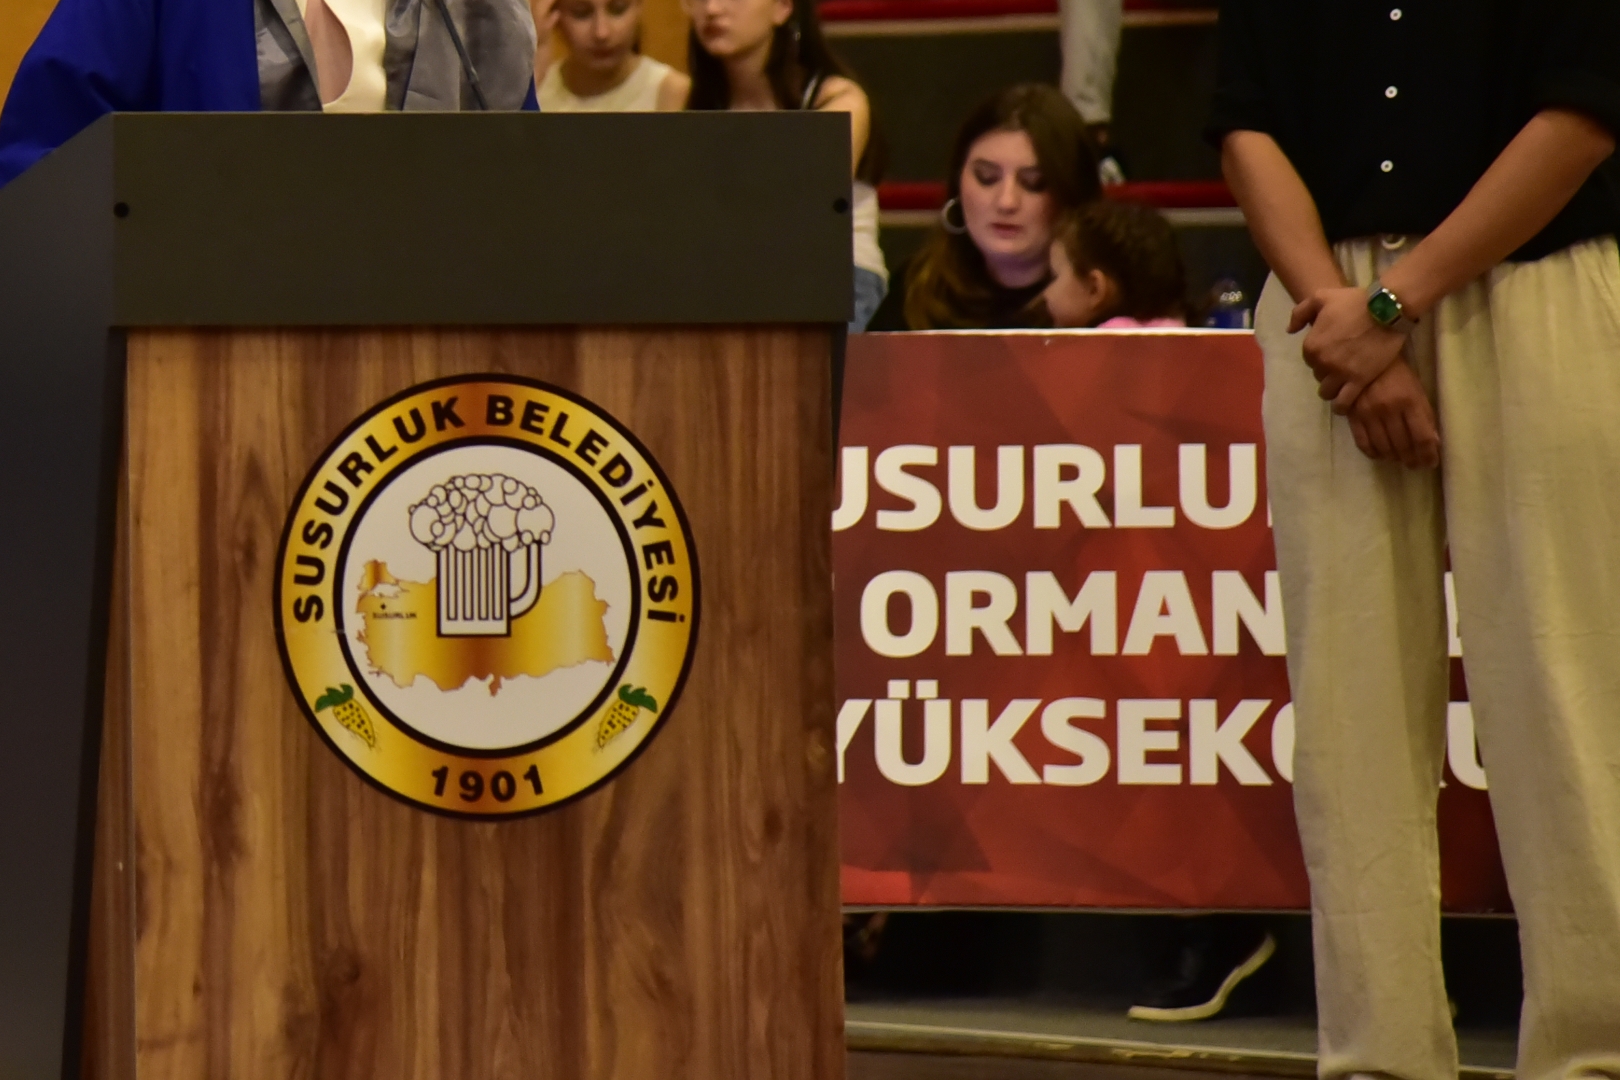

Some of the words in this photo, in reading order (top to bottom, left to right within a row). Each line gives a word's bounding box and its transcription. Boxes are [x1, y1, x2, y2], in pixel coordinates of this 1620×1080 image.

[293, 395, 465, 624] SUSURLUK
[486, 394, 685, 624] BELEDİYESİ
[861, 570, 1288, 657] ORMAN
[431, 765, 544, 802] 1901
